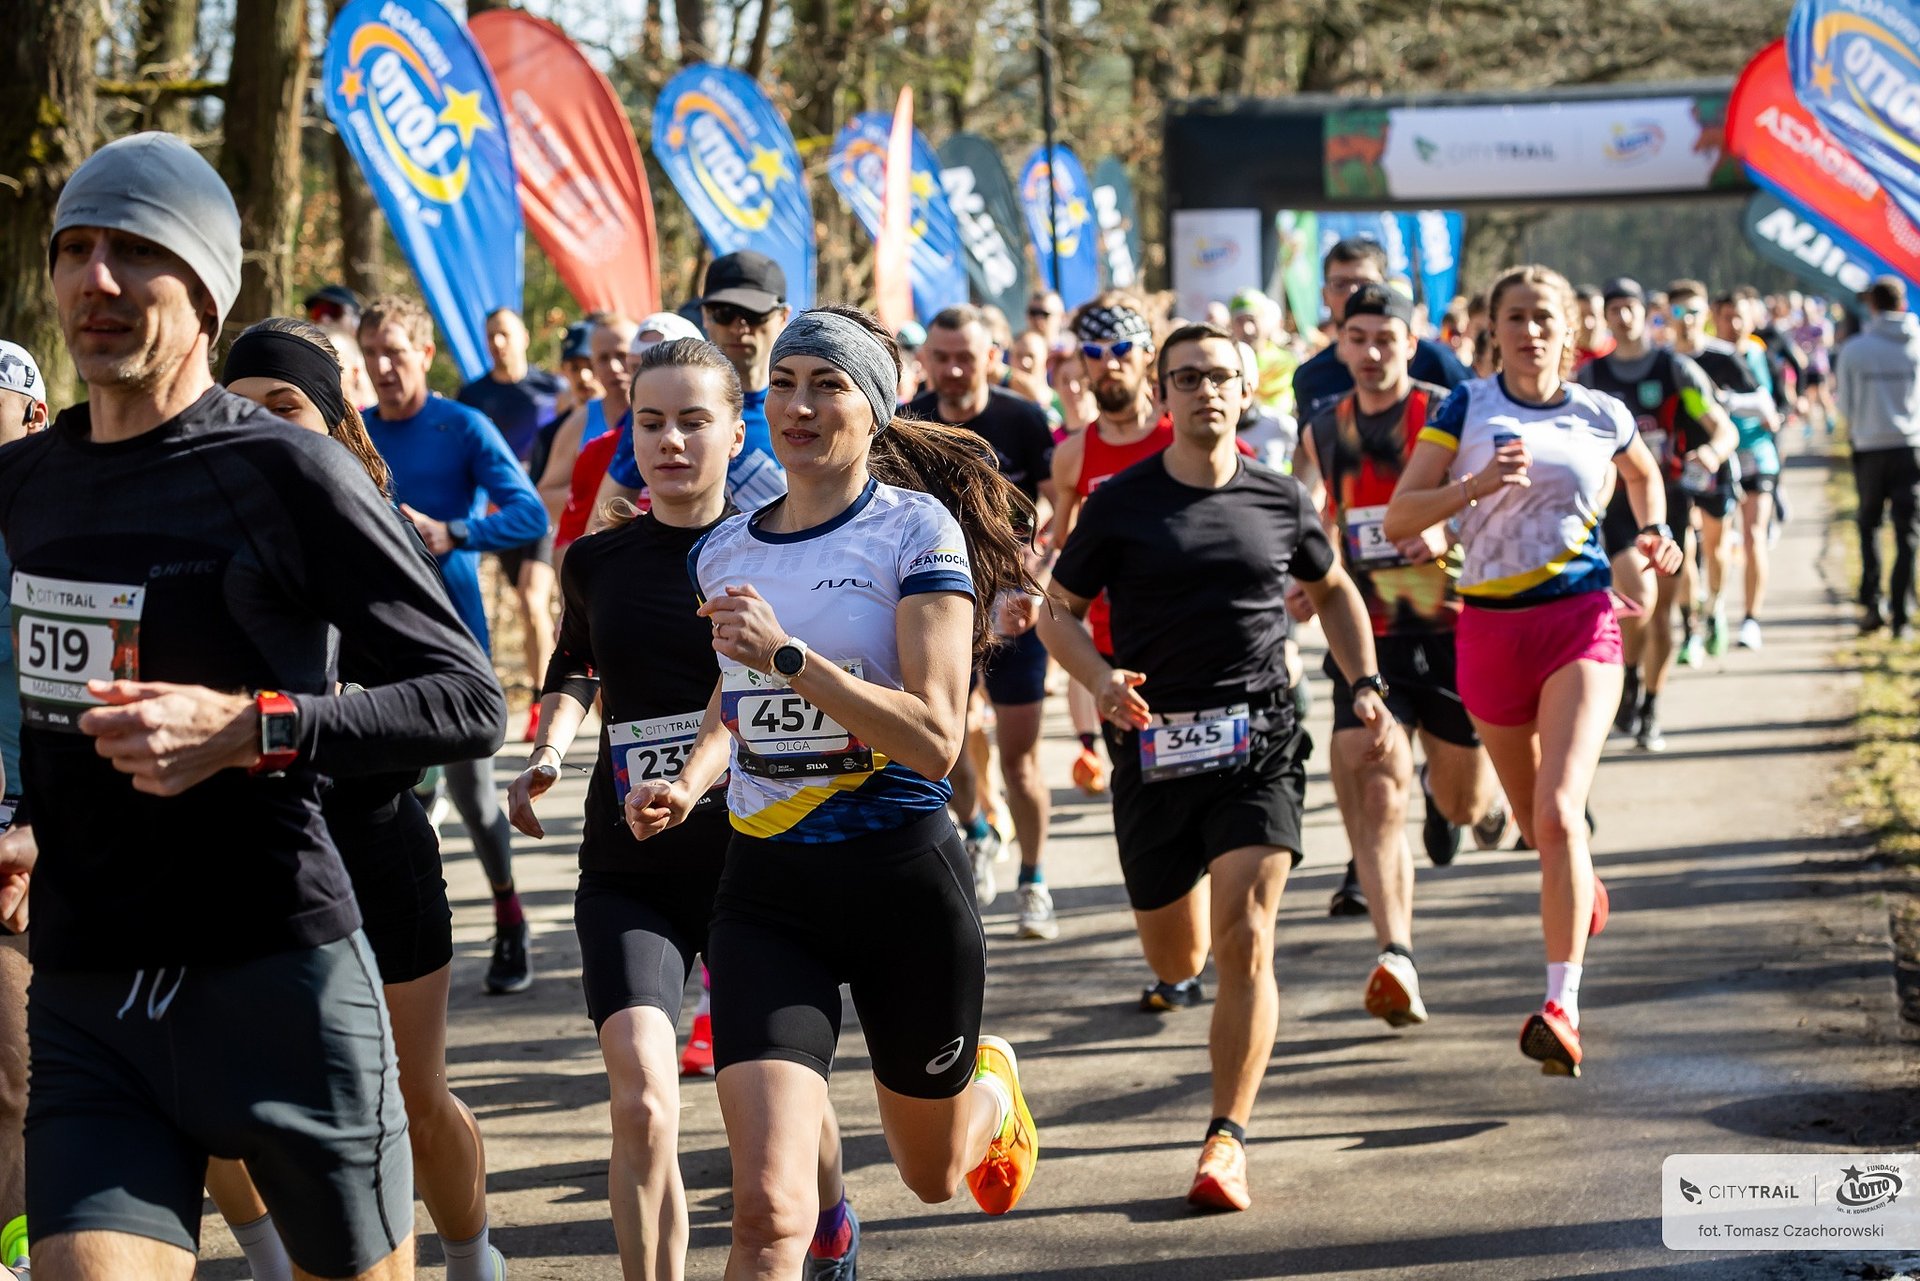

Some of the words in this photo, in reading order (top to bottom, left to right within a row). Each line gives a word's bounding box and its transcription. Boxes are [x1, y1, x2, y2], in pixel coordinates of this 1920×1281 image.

[29, 623, 89, 673] 519
[33, 681, 82, 700] MARIUSZ
[776, 741, 810, 751] OLGA
[1167, 725, 1222, 749] 345
[637, 744, 694, 781] 23
